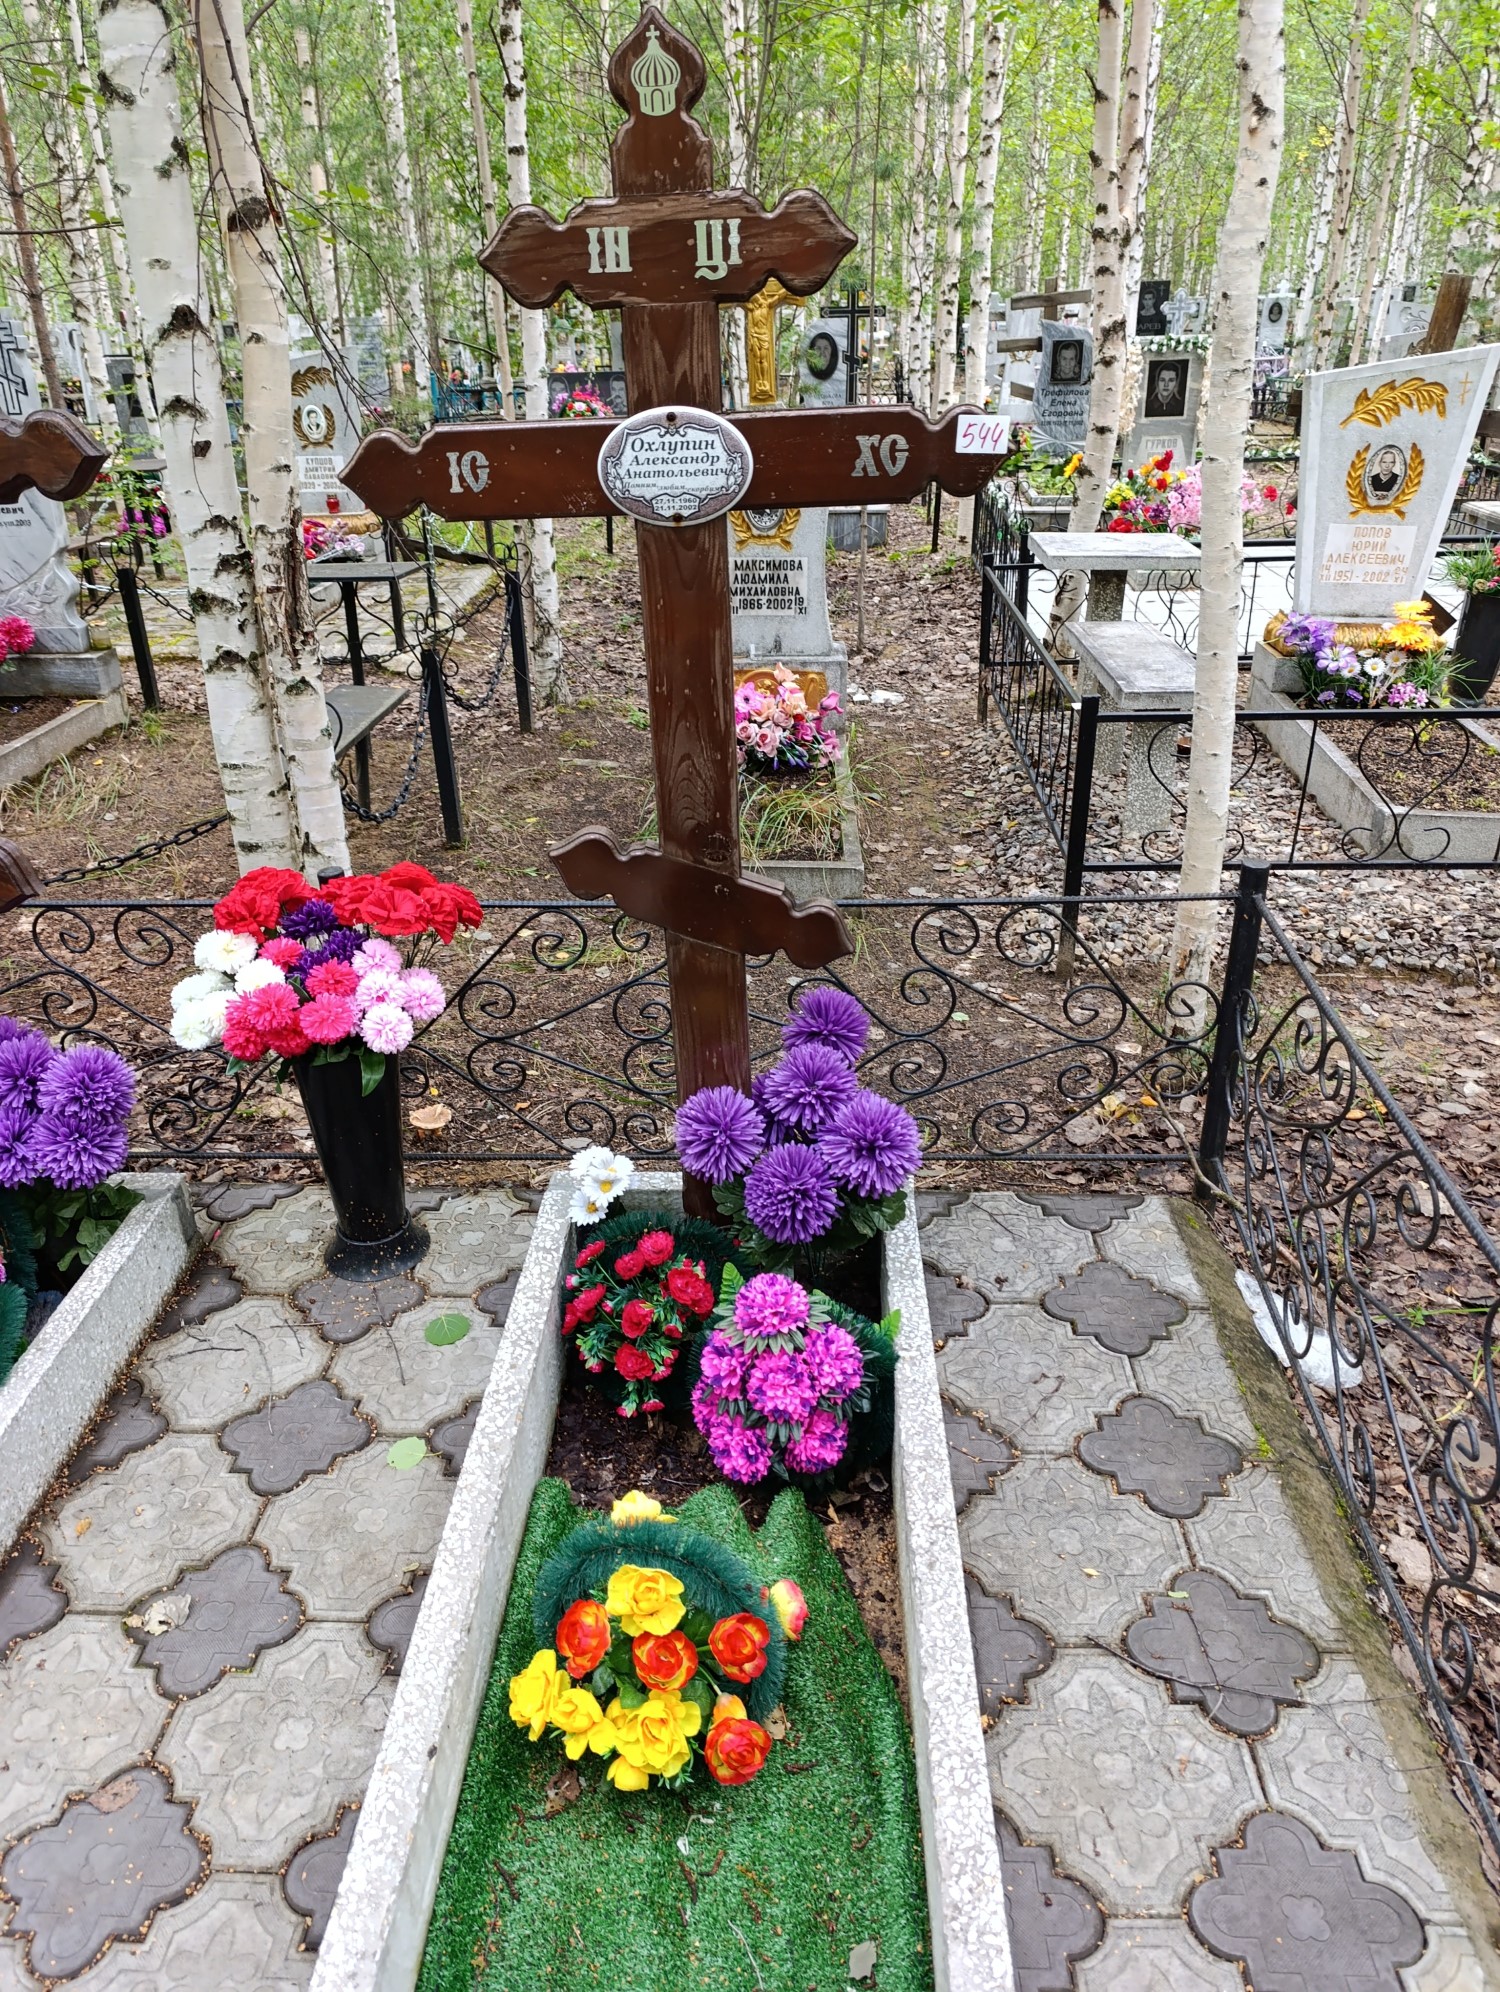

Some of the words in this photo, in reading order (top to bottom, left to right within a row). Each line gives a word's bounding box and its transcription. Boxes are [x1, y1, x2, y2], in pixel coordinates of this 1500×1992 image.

[1041, 389, 1089, 397] Трефилова
[1042, 409, 1084, 418] Егоровна
[962, 422, 1004, 452] 544
[631, 438, 715, 455] Охлупин
[1145, 438, 1178, 449] ГУРКОВ
[630, 452, 720, 466] Александр
[305, 465, 336, 473] ДМИТРИЙ
[622, 467, 729, 479] Анатольевич
[1, 506, 24, 514] евич
[1353, 526, 1392, 538] ПОПОВ
[1352, 540, 1387, 552] ЮРИЙ
[1327, 553, 1405, 565] АЛЕКСЕЕВИЧ
[734, 560, 803, 571] МАКСИМОВА
[733, 573, 789, 585] ЛЮДМИЛА
[1333, 570, 1354, 581] 1951
[1362, 571, 1391, 582] 2002
[730, 584, 801, 596] МИХАЙЛОВНА
